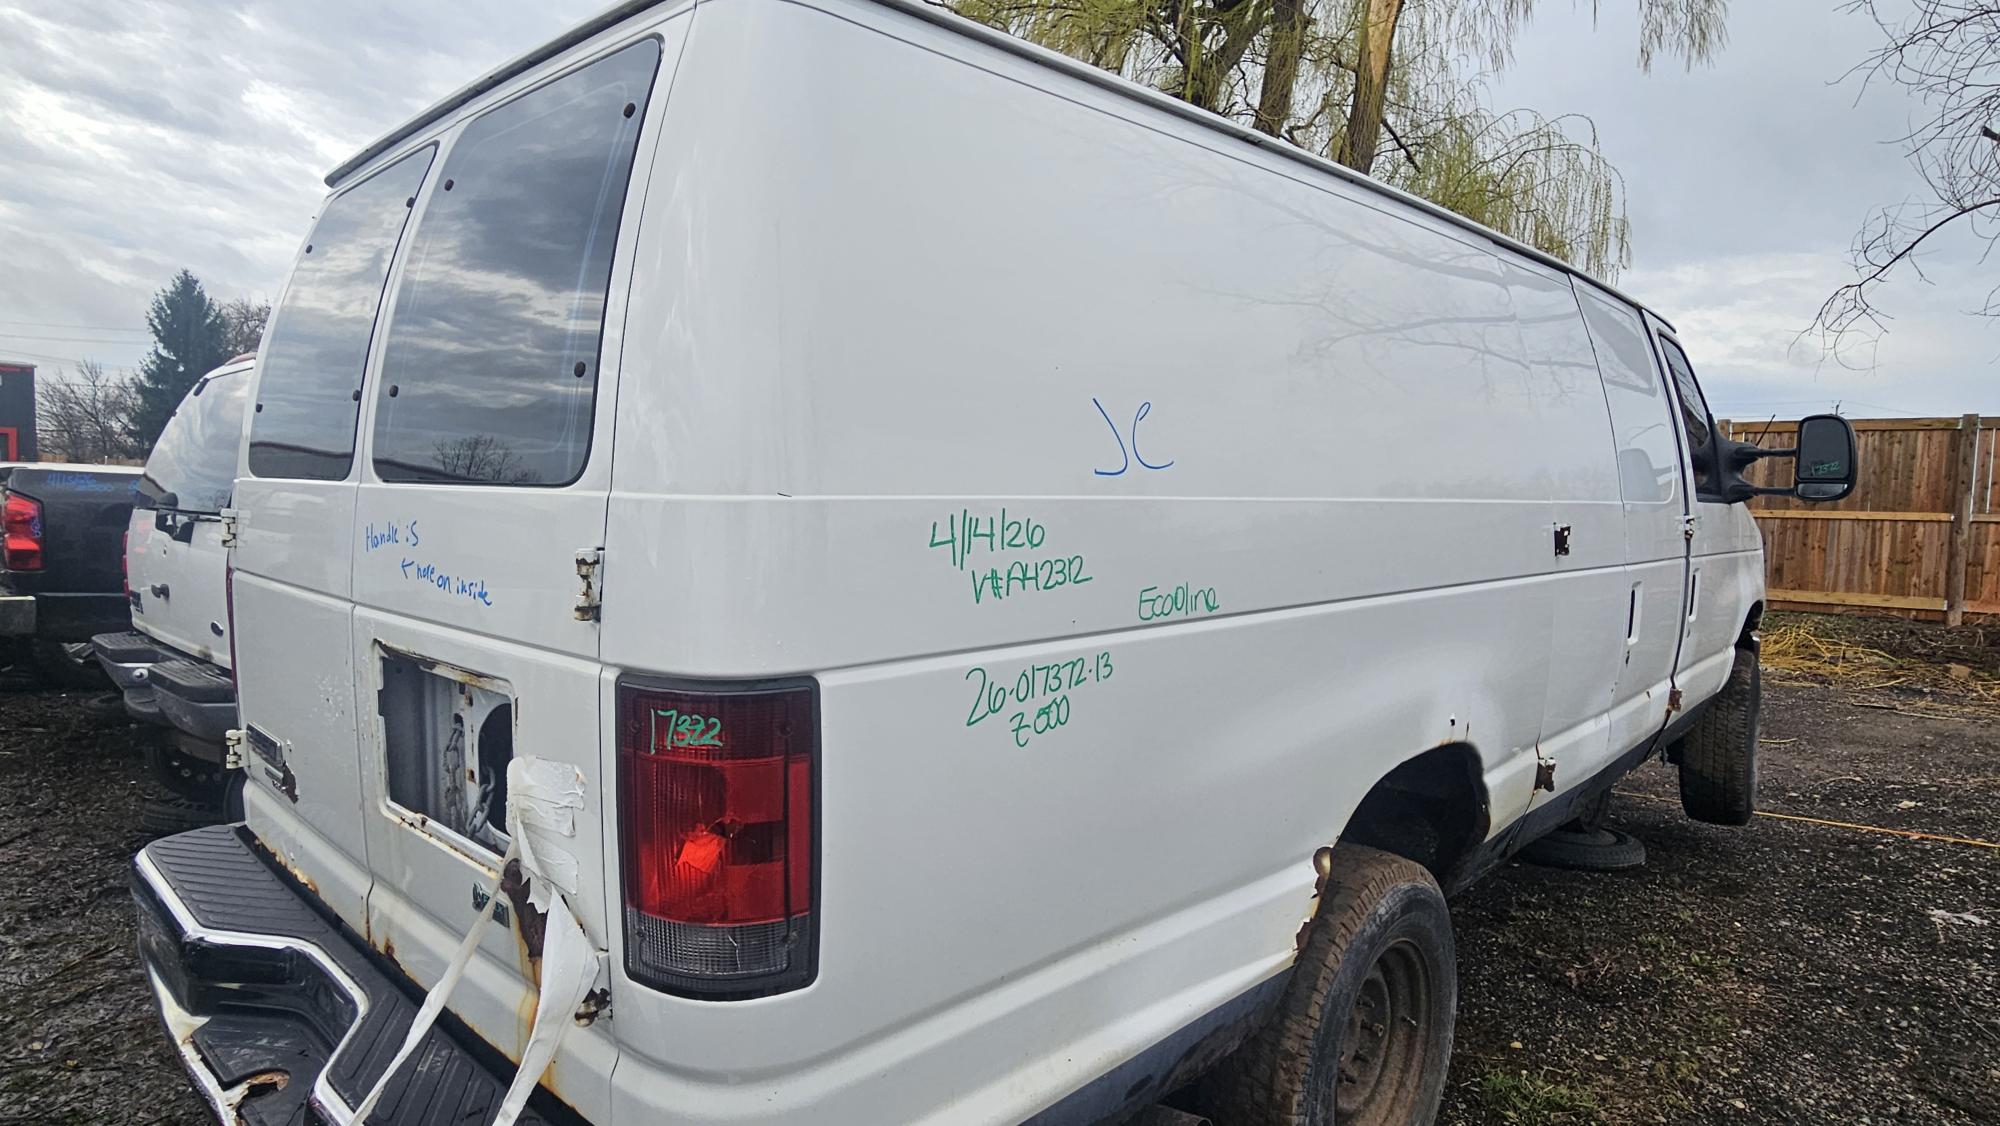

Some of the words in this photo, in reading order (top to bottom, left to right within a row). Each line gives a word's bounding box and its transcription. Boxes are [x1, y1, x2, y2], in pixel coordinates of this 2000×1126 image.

[365, 521, 399, 553] Handle
[929, 507, 1046, 571] 4/14/26
[416, 563, 435, 584] here
[436, 574, 452, 595] on
[456, 576, 493, 607] inside
